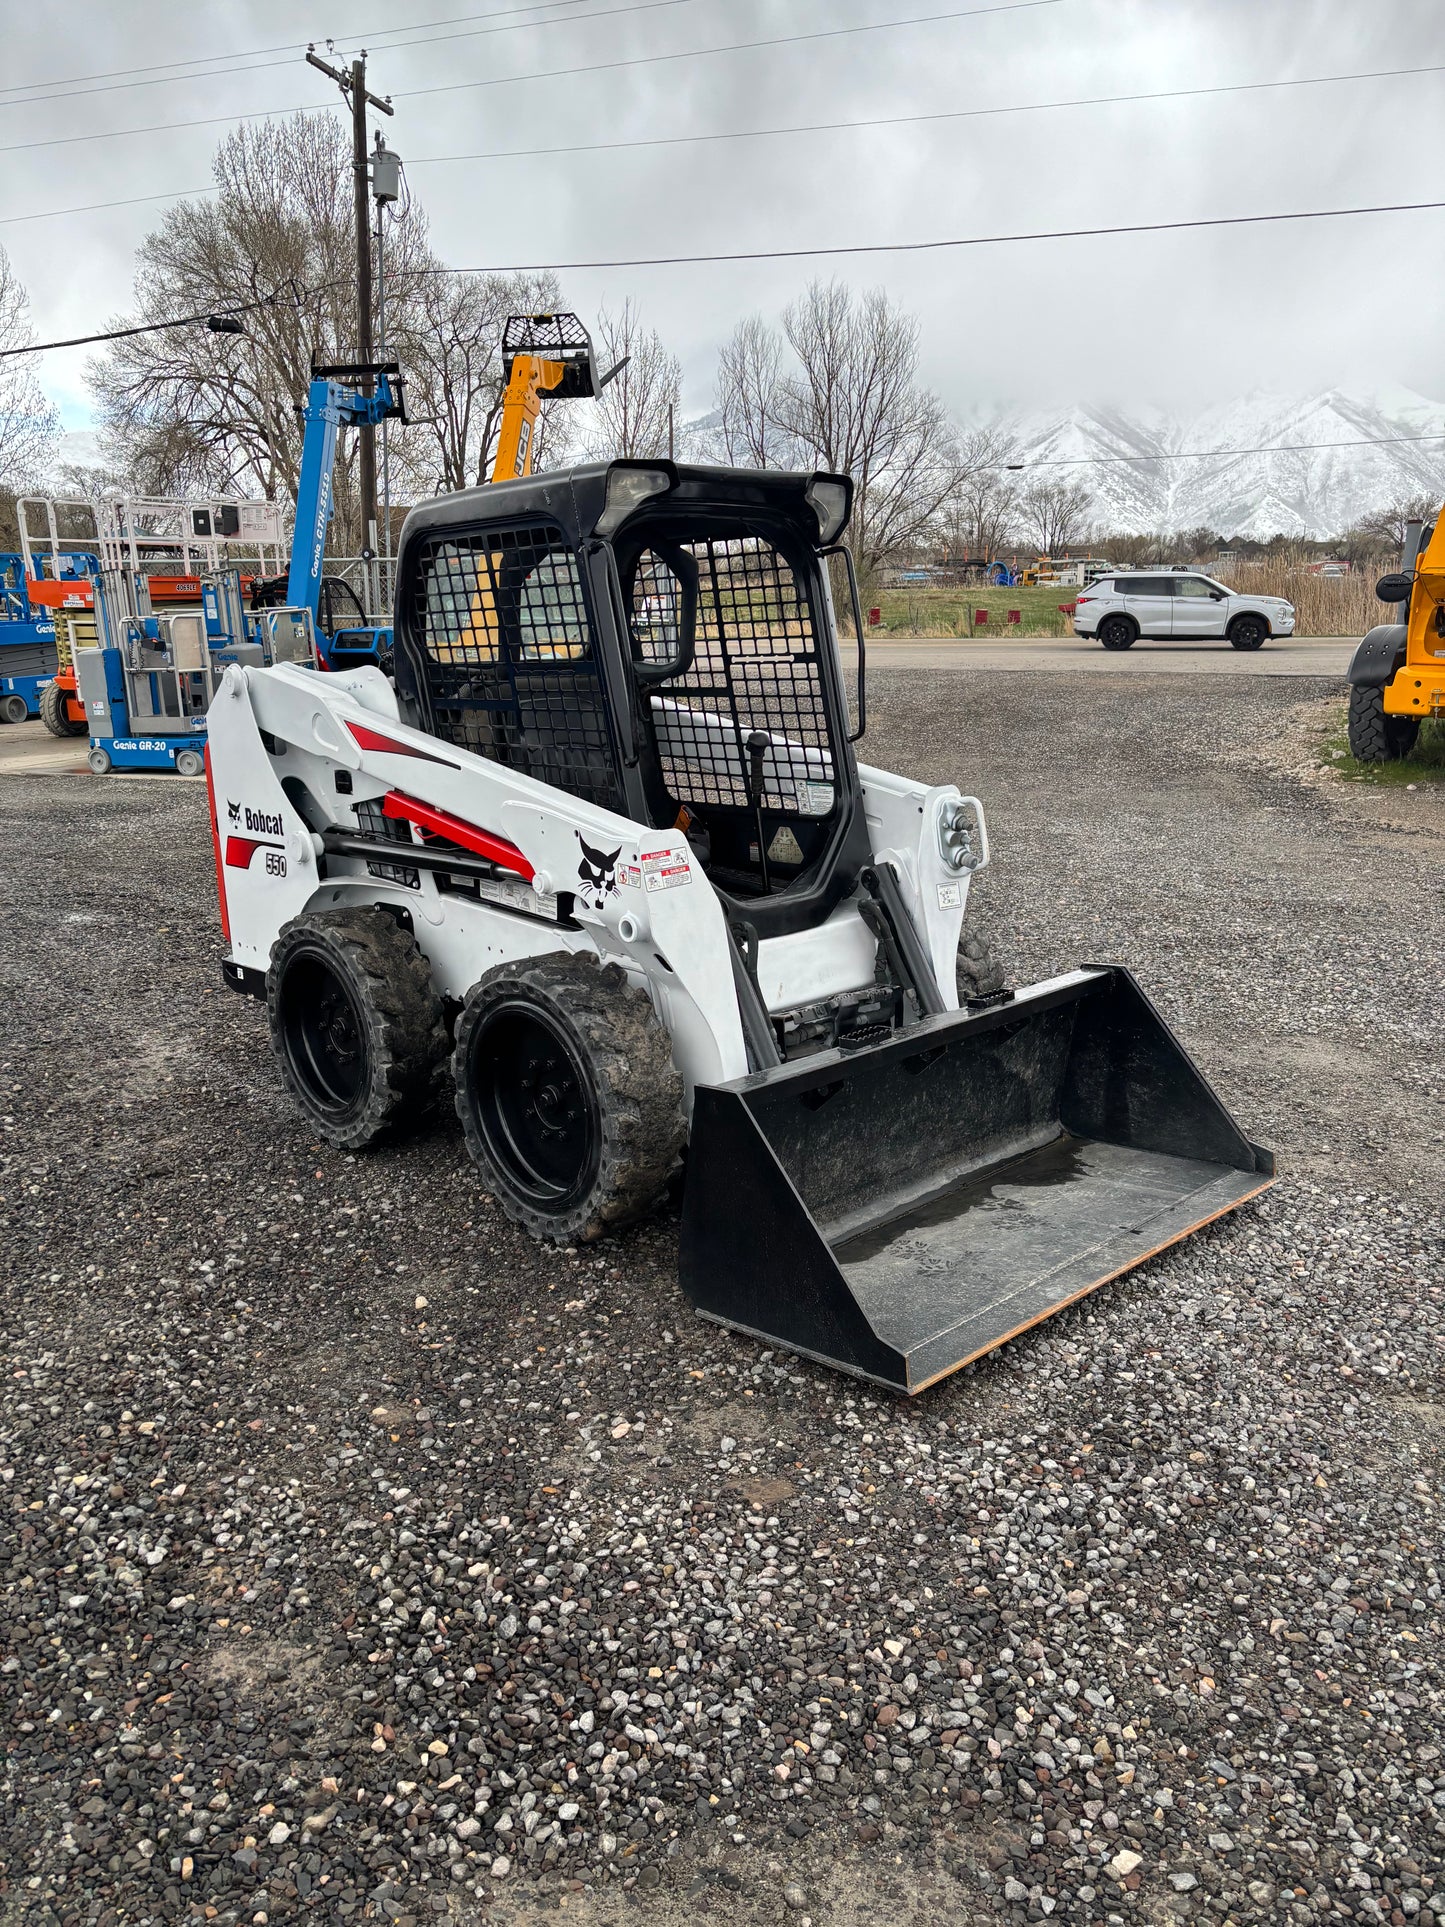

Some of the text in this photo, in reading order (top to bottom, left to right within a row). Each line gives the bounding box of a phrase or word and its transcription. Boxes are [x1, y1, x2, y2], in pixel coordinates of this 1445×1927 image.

[514, 417, 531, 477] JCB
[311, 472, 330, 578] Genie GTH-5519
[217, 652, 239, 661] Genie
[113, 740, 166, 751] Genie GR-20
[244, 807, 284, 836] Bobcat
[650, 851, 667, 859] DANGER
[266, 852, 287, 878] 550
[670, 866, 686, 874] DANGER
